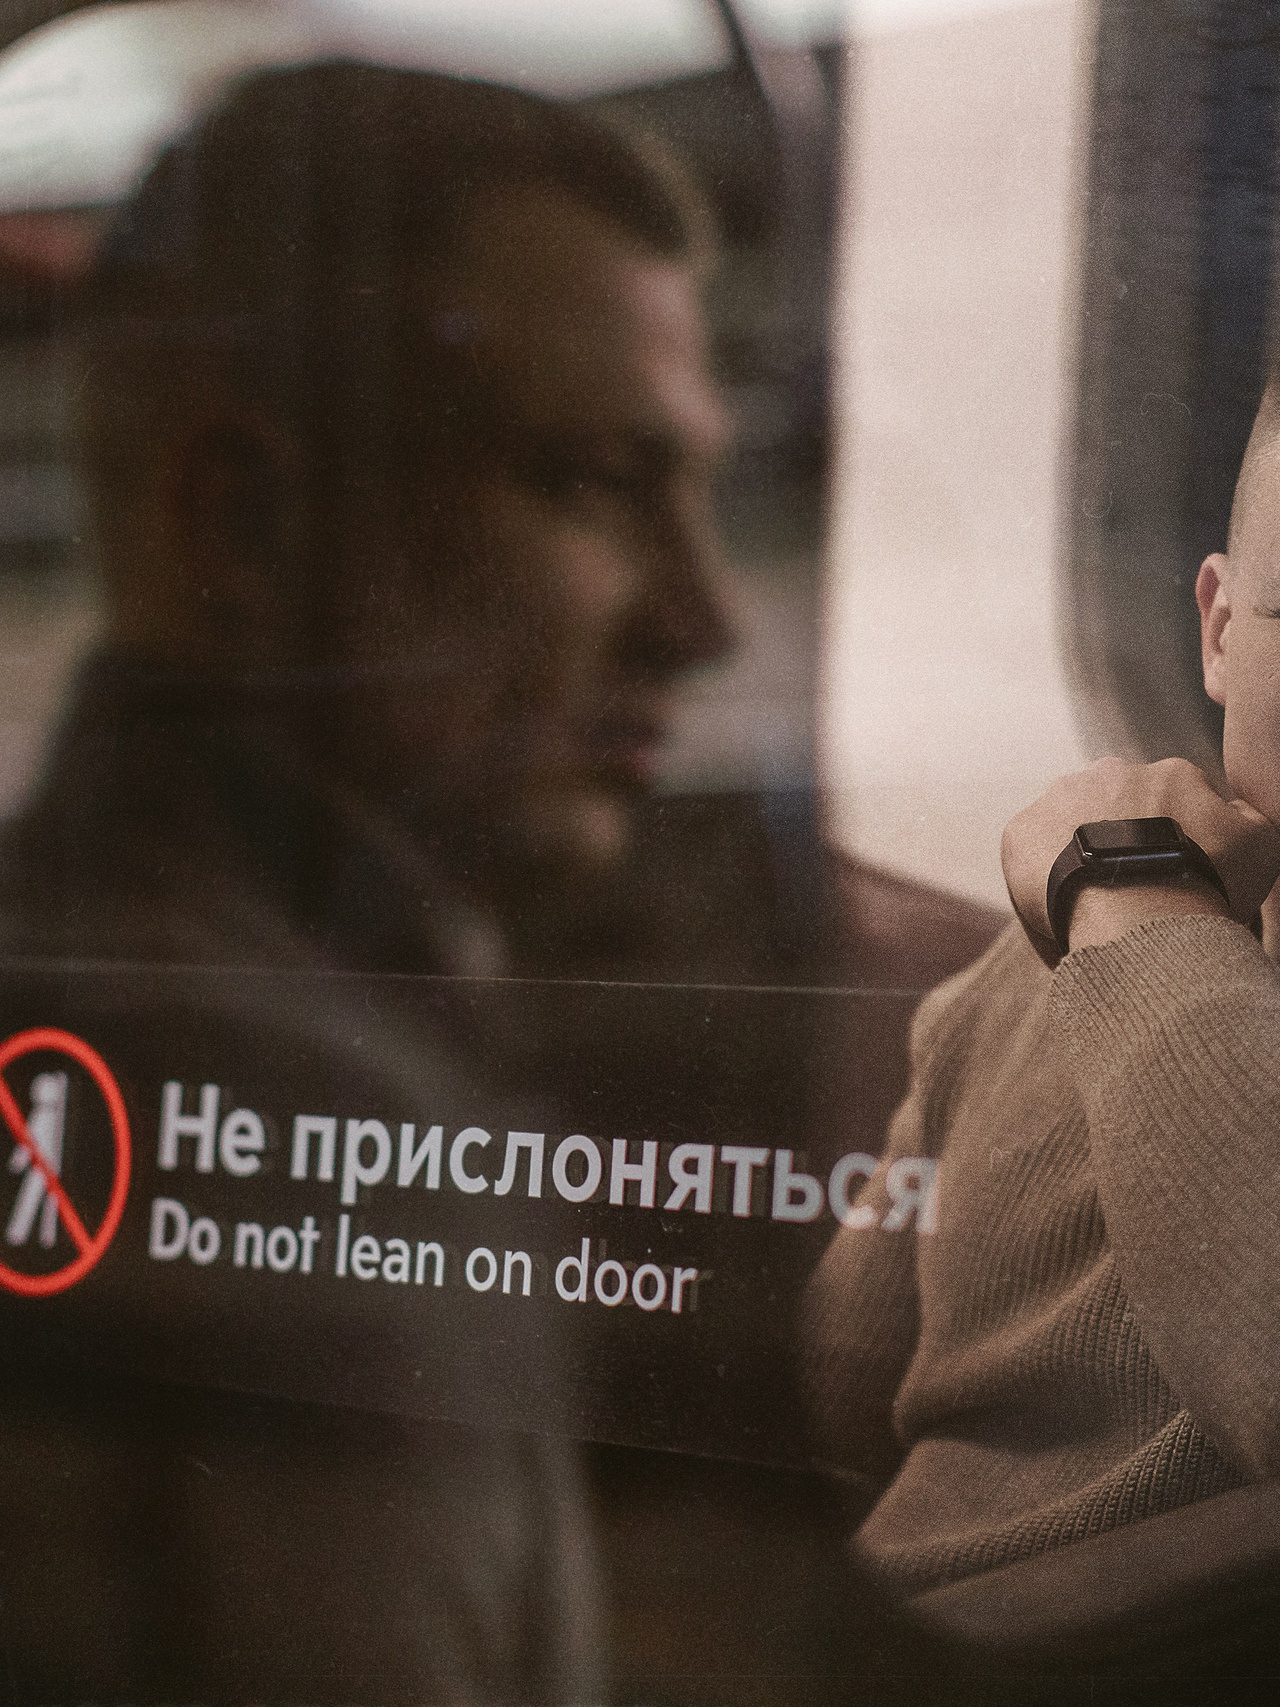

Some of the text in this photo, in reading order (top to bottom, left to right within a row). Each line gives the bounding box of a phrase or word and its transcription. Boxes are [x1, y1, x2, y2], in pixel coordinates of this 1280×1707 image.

[157, 1080, 938, 1232] Не прислоняться
[148, 1197, 698, 1313] Do not lean on door
